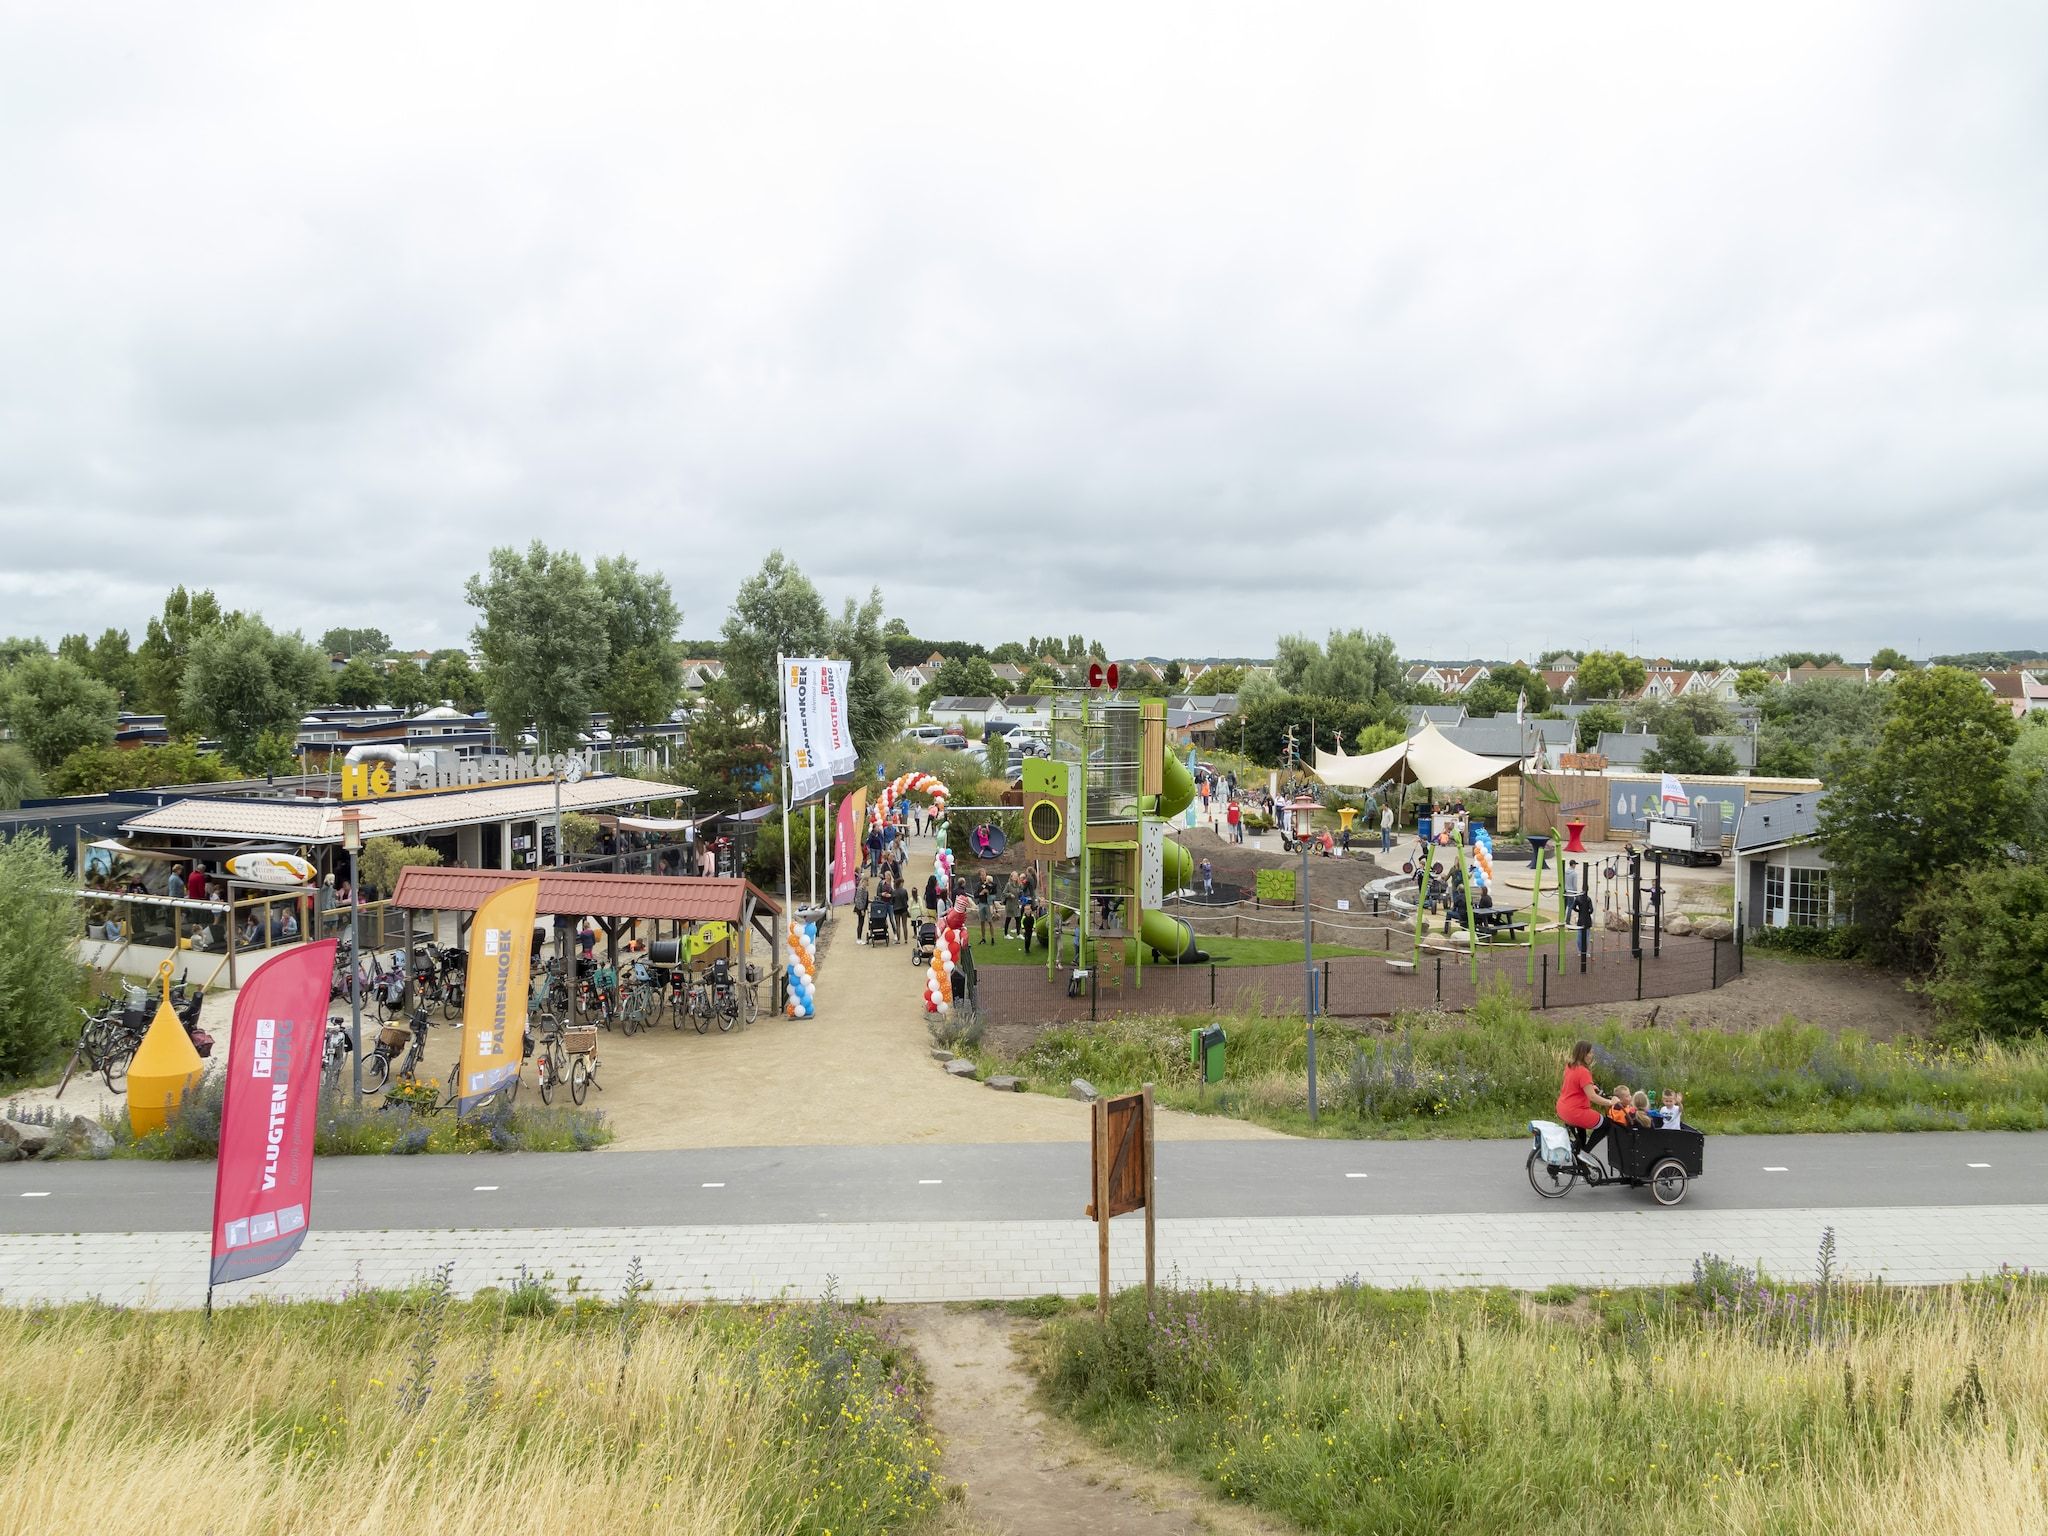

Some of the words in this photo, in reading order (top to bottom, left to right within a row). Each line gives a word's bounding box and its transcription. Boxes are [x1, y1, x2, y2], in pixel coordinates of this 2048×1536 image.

[798, 666, 814, 768] PANNENKOEK
[828, 667, 841, 750] VLUGTENBURG
[342, 762, 390, 799] Hé
[795, 748, 808, 769] HÉ
[492, 929, 512, 1055] PANNENKOEK
[478, 1030, 492, 1055] HÉ
[261, 1019, 294, 1190] VLUGTENBURG
